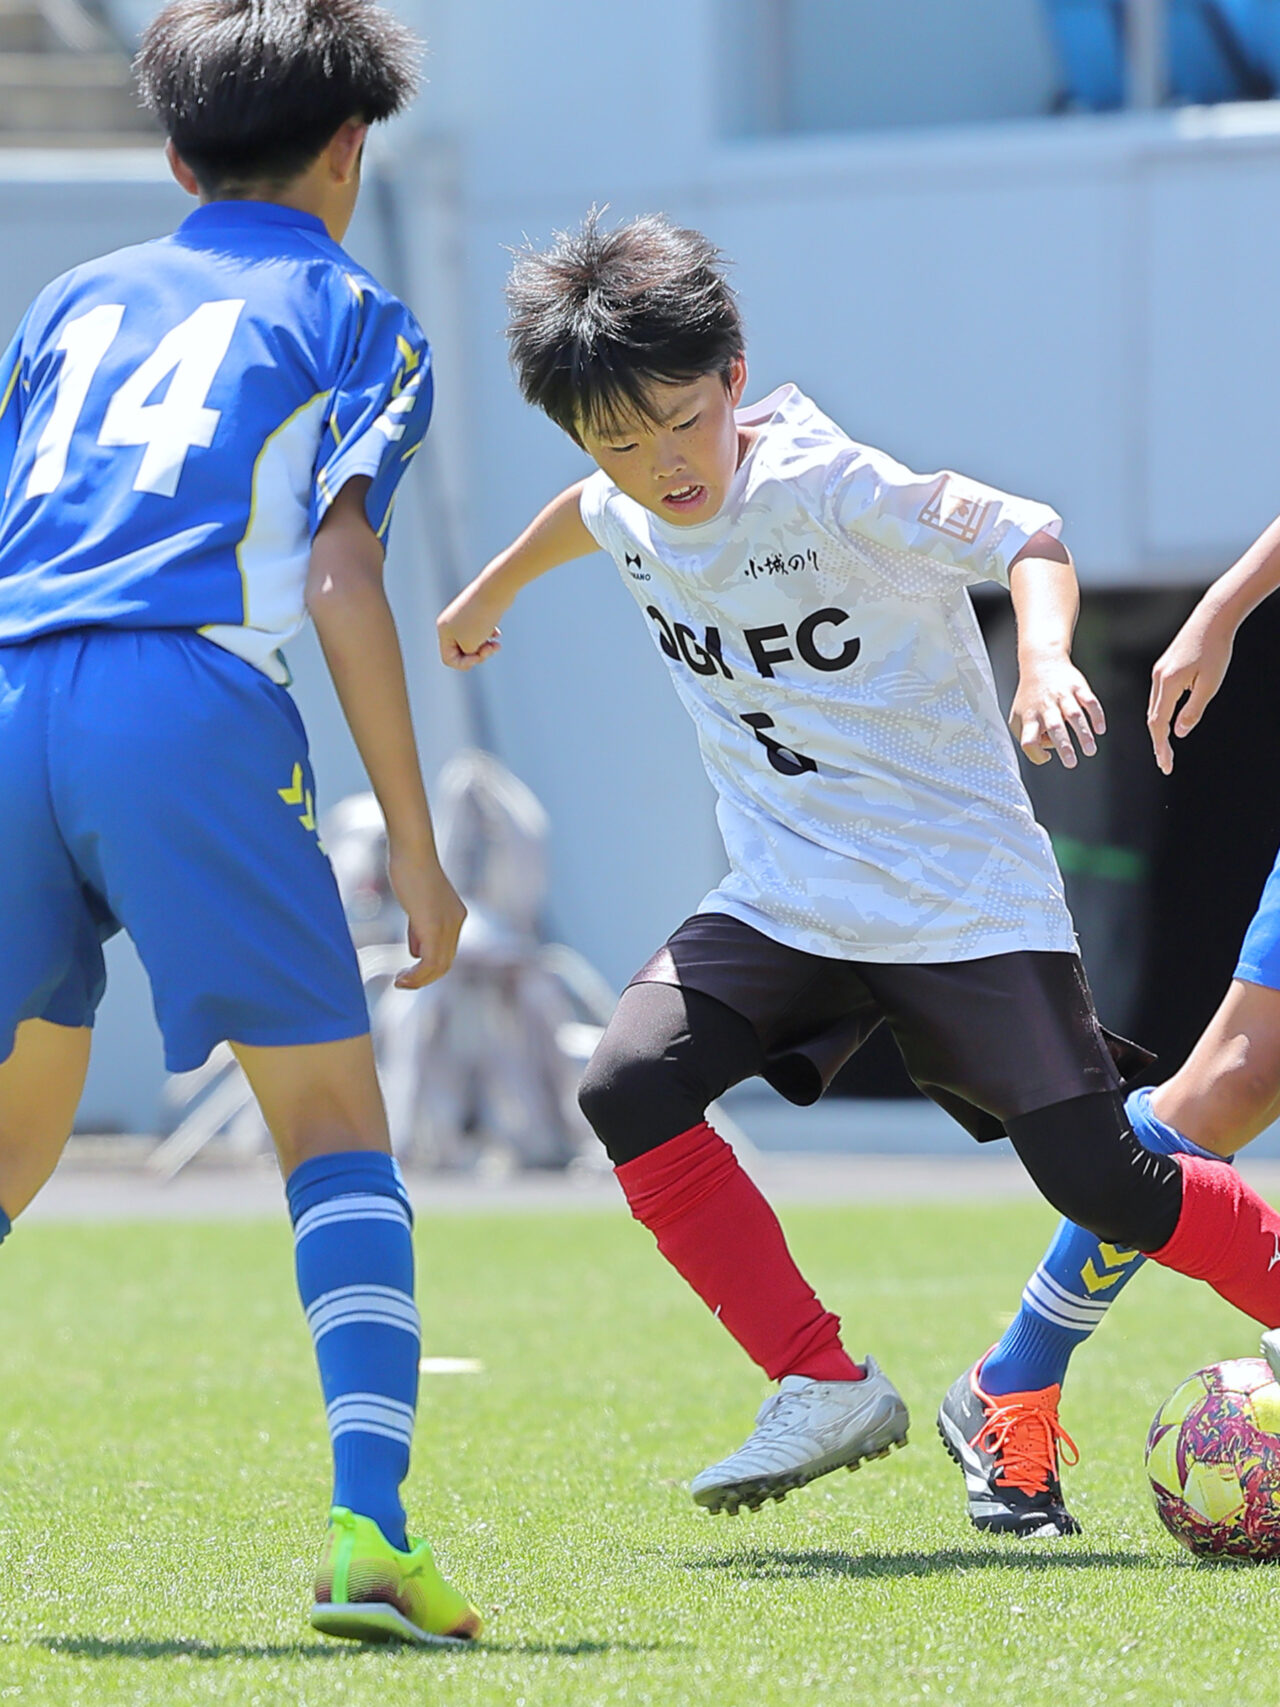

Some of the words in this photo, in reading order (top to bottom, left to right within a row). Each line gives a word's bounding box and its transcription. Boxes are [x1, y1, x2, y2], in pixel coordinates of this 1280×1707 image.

[25, 299, 246, 500] 14
[744, 548, 819, 580] 小城のり
[743, 607, 861, 679] FC
